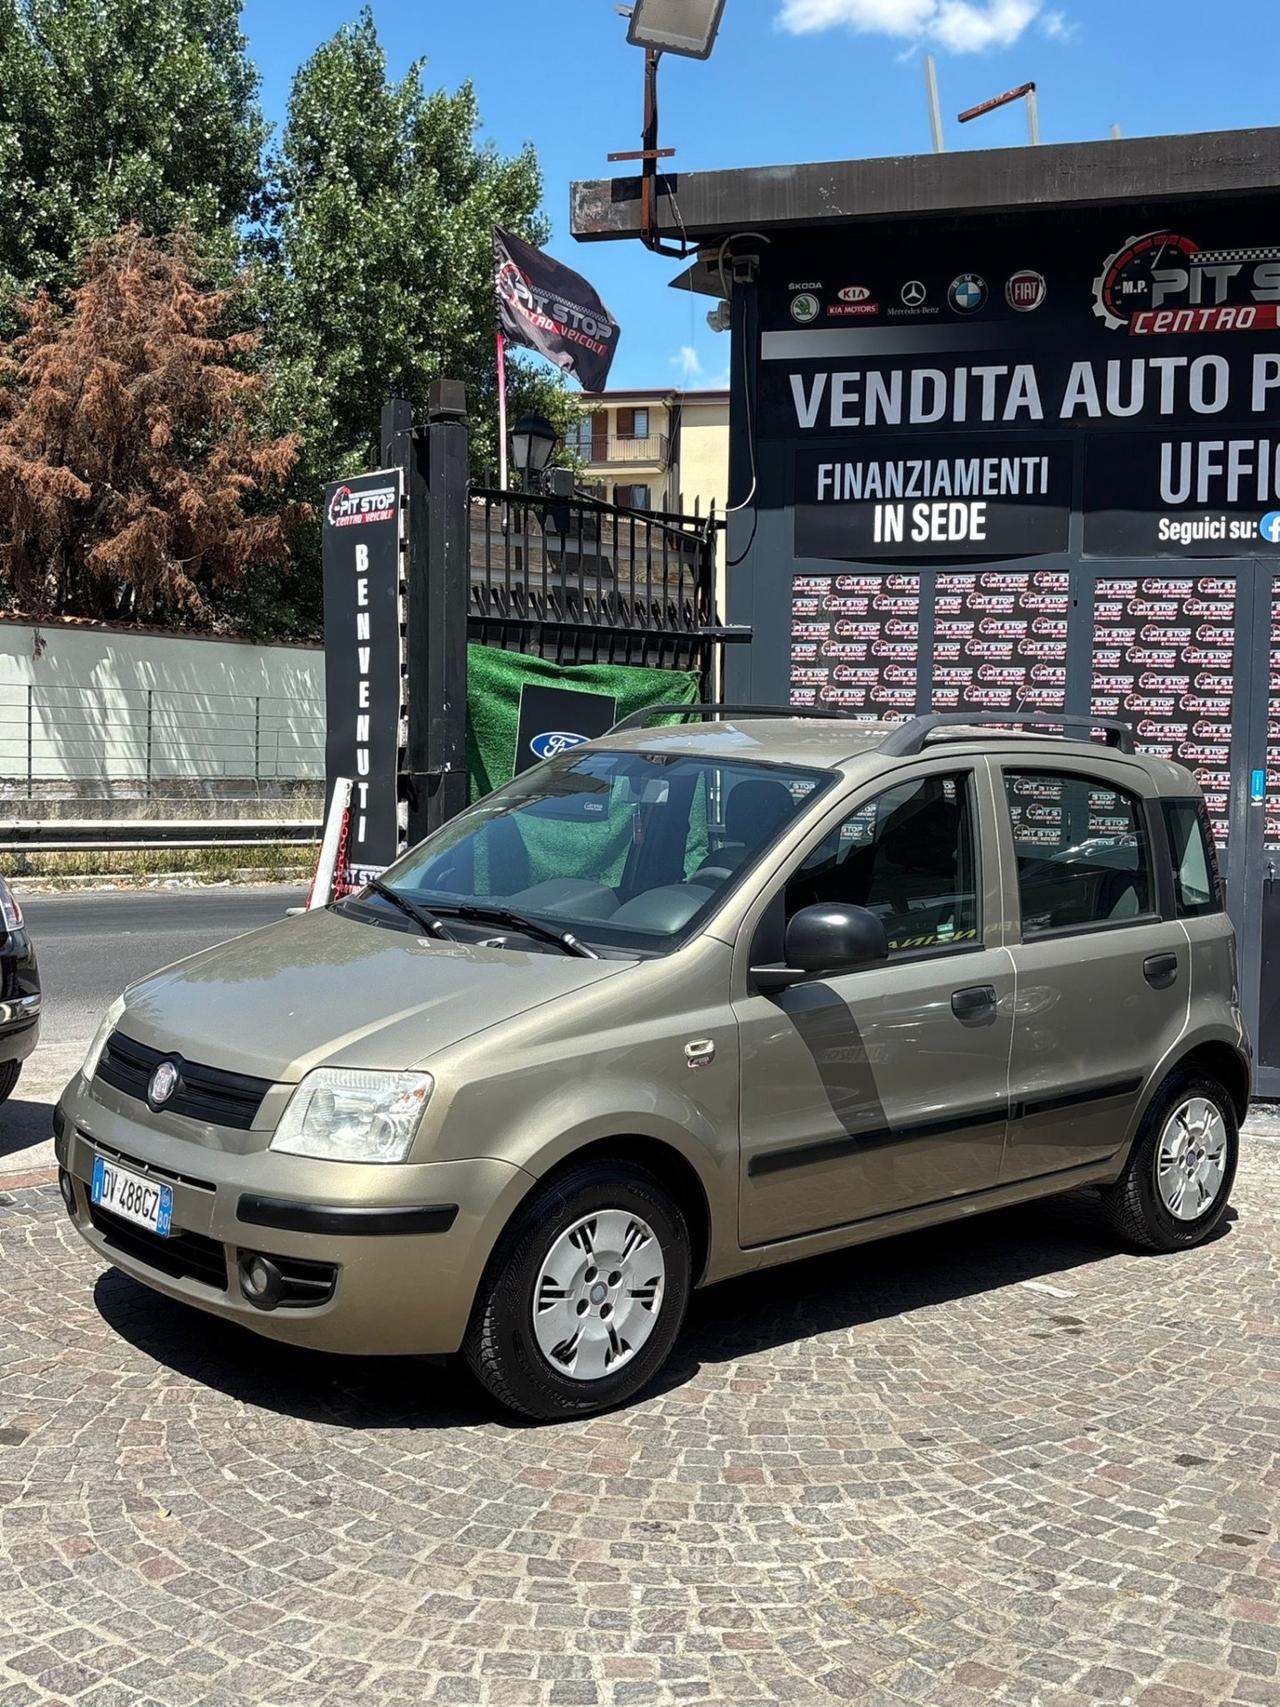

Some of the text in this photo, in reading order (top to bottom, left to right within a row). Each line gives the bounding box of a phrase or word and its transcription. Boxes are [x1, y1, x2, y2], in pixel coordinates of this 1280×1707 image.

[843, 289, 866, 299] KIA
[1014, 282, 1038, 300] FIAT
[1151, 264, 1243, 309] PIT
[552, 303, 613, 341] STOP
[829, 305, 876, 314] KIA MOTORS
[887, 306, 939, 316] Mercedes-Benz
[788, 364, 1044, 429] VENDITA
[1059, 355, 1230, 420] AUTO
[817, 456, 1049, 501] FINANZIAMENTI
[340, 493, 395, 515] PIT STOP
[873, 502, 987, 543] IN SEDE
[1158, 515, 1258, 546] Seguici su:
[355, 544, 371, 843] BENVENUTI
